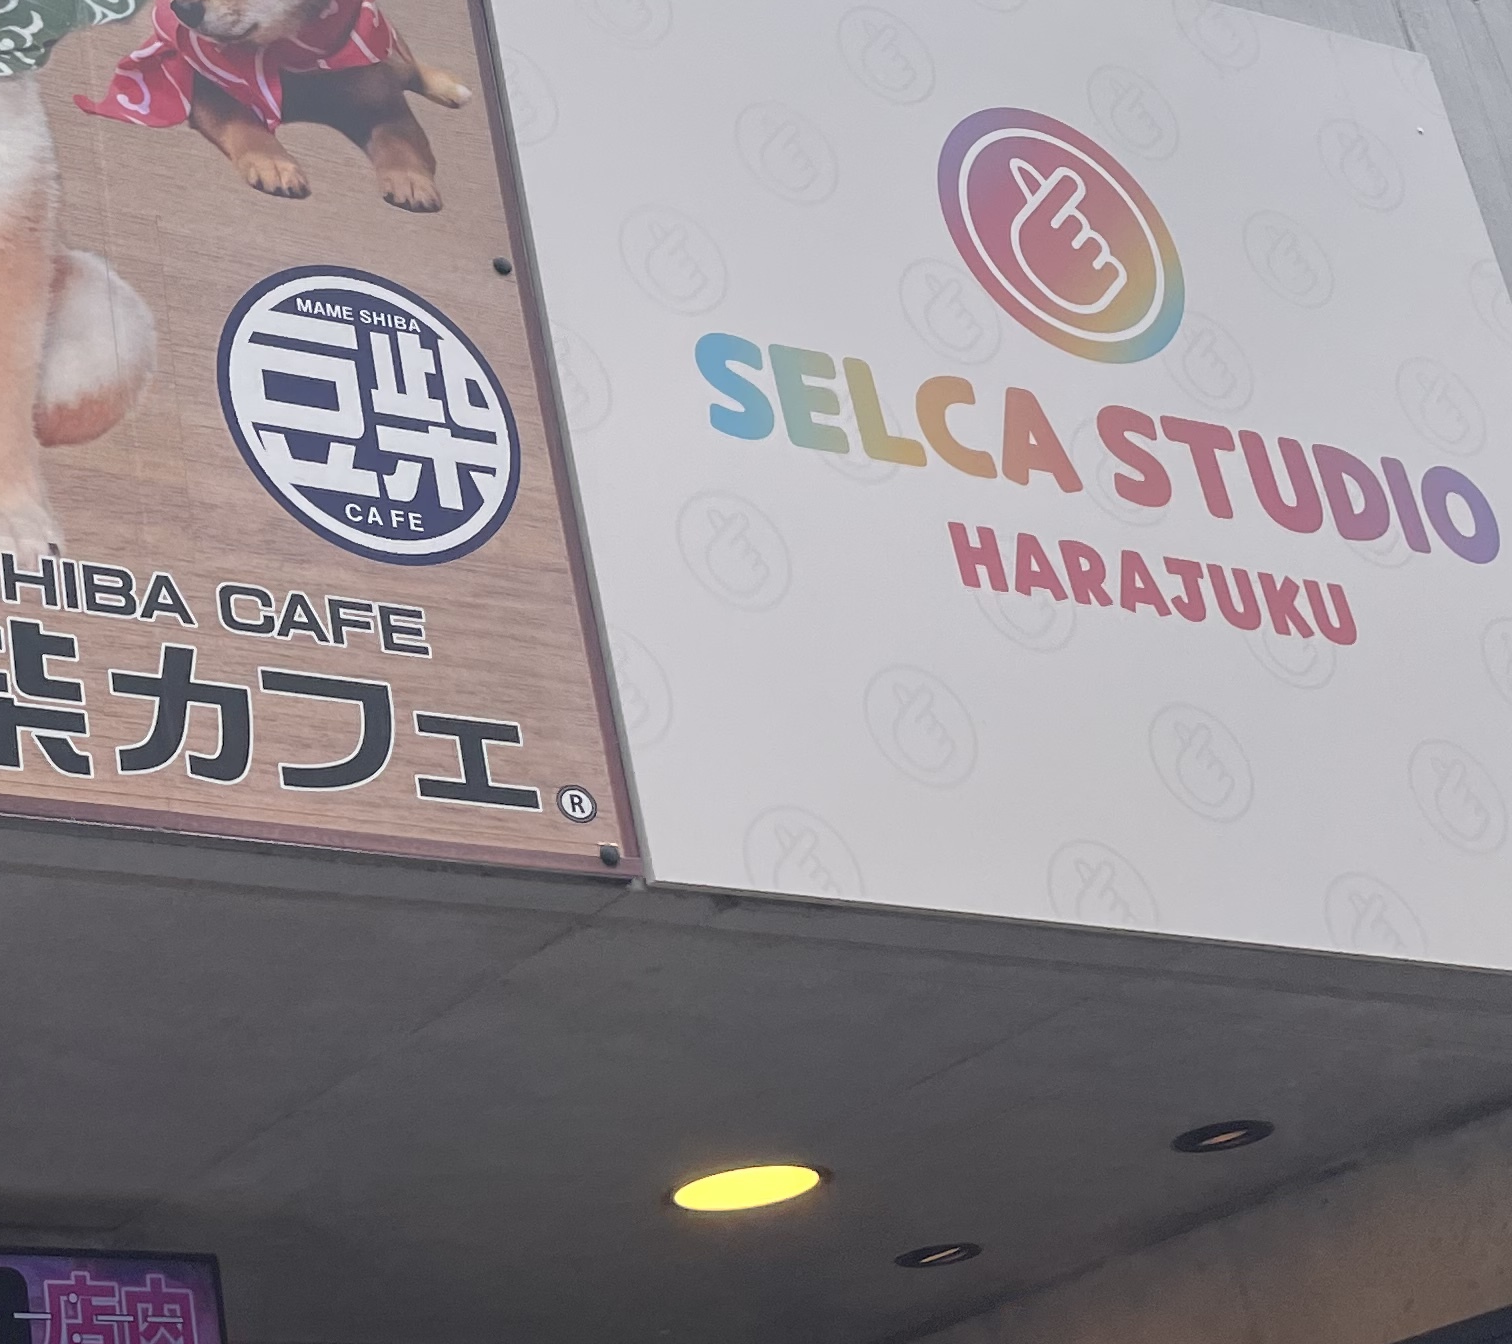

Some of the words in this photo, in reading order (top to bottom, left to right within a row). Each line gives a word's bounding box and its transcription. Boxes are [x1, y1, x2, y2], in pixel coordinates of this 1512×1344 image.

[295, 297, 355, 321] MAME
[359, 309, 422, 333] SHIBA
[694, 332, 1084, 494] SELCA
[1096, 405, 1501, 565] STUDIO
[344, 503, 425, 532] CAFE
[217, 581, 433, 659] CAFE
[947, 521, 1358, 646] HARAJUKU
